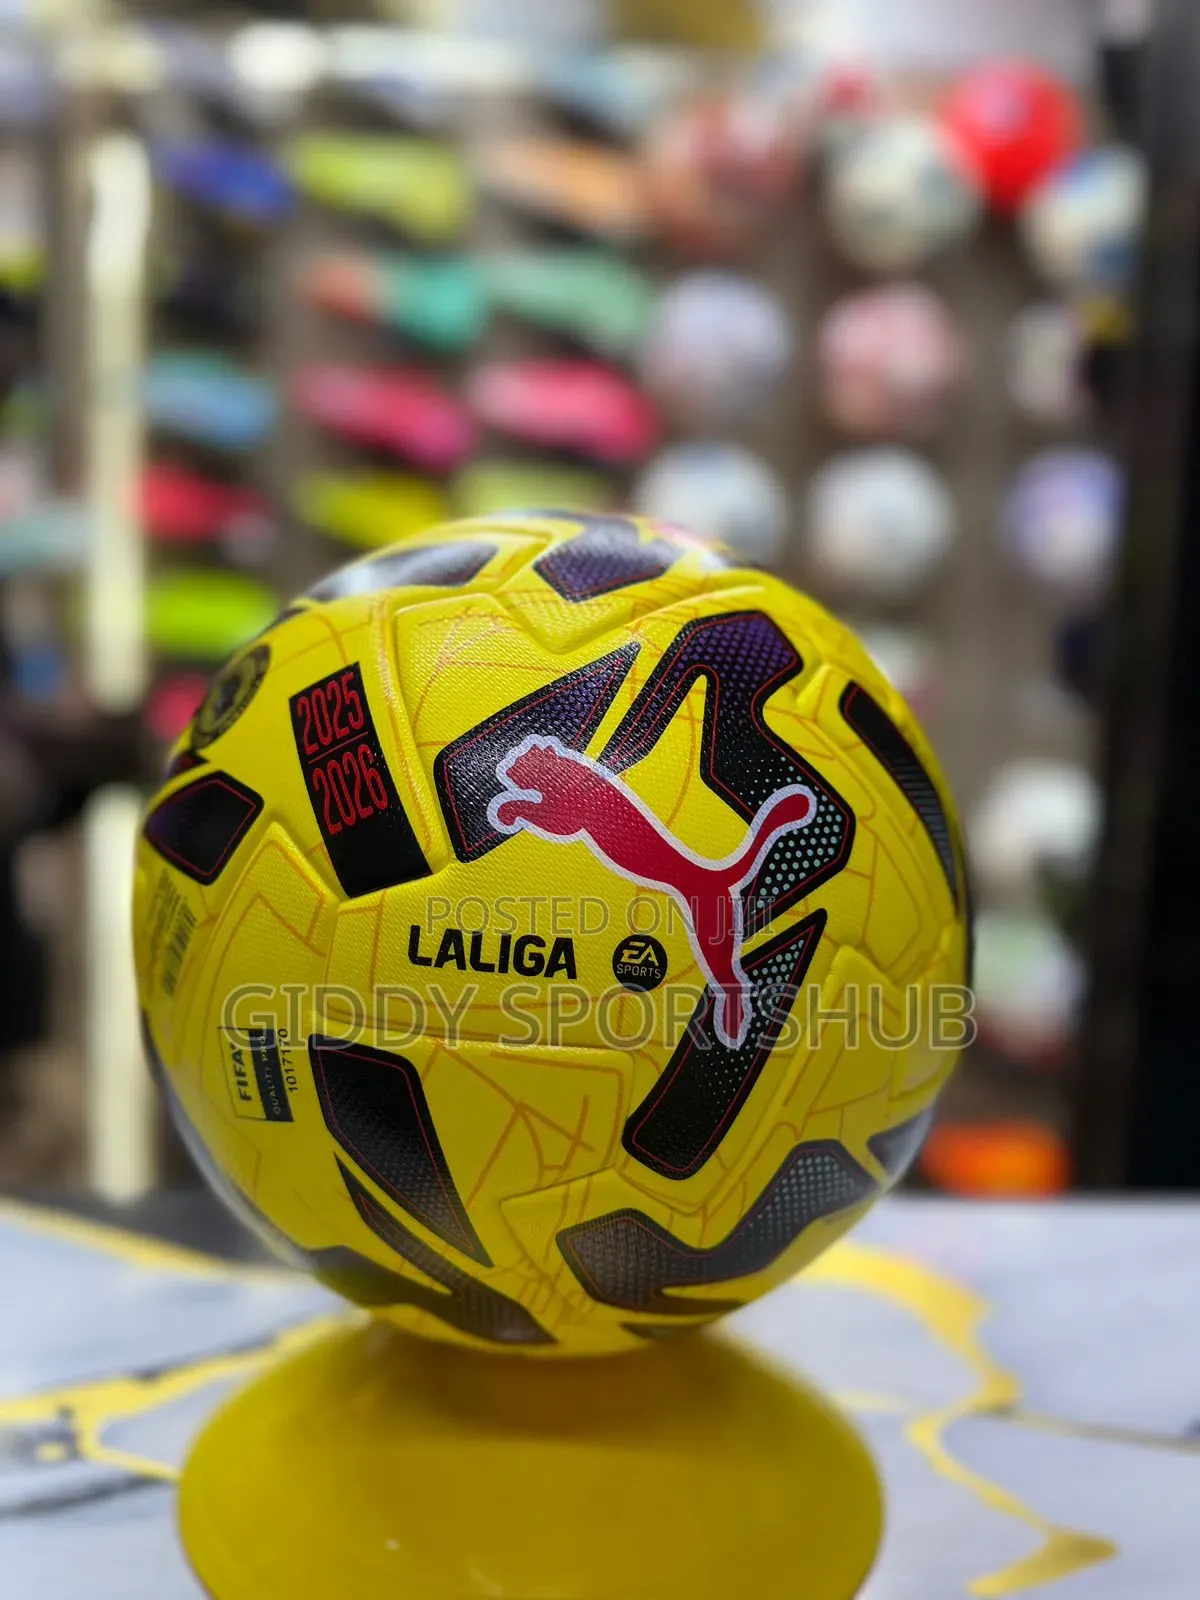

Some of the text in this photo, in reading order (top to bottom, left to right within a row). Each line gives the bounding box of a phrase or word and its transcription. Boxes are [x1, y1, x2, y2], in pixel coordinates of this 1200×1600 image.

[296, 671, 365, 756] 2025
[311, 743, 389, 837] 2026
[407, 924, 578, 980] LALIGA
[616, 963, 661, 979] SPORTS
[620, 941, 659, 967] EA
[231, 1046, 252, 1102] FIFA
[259, 1035, 281, 1115] QUALITY PRO
